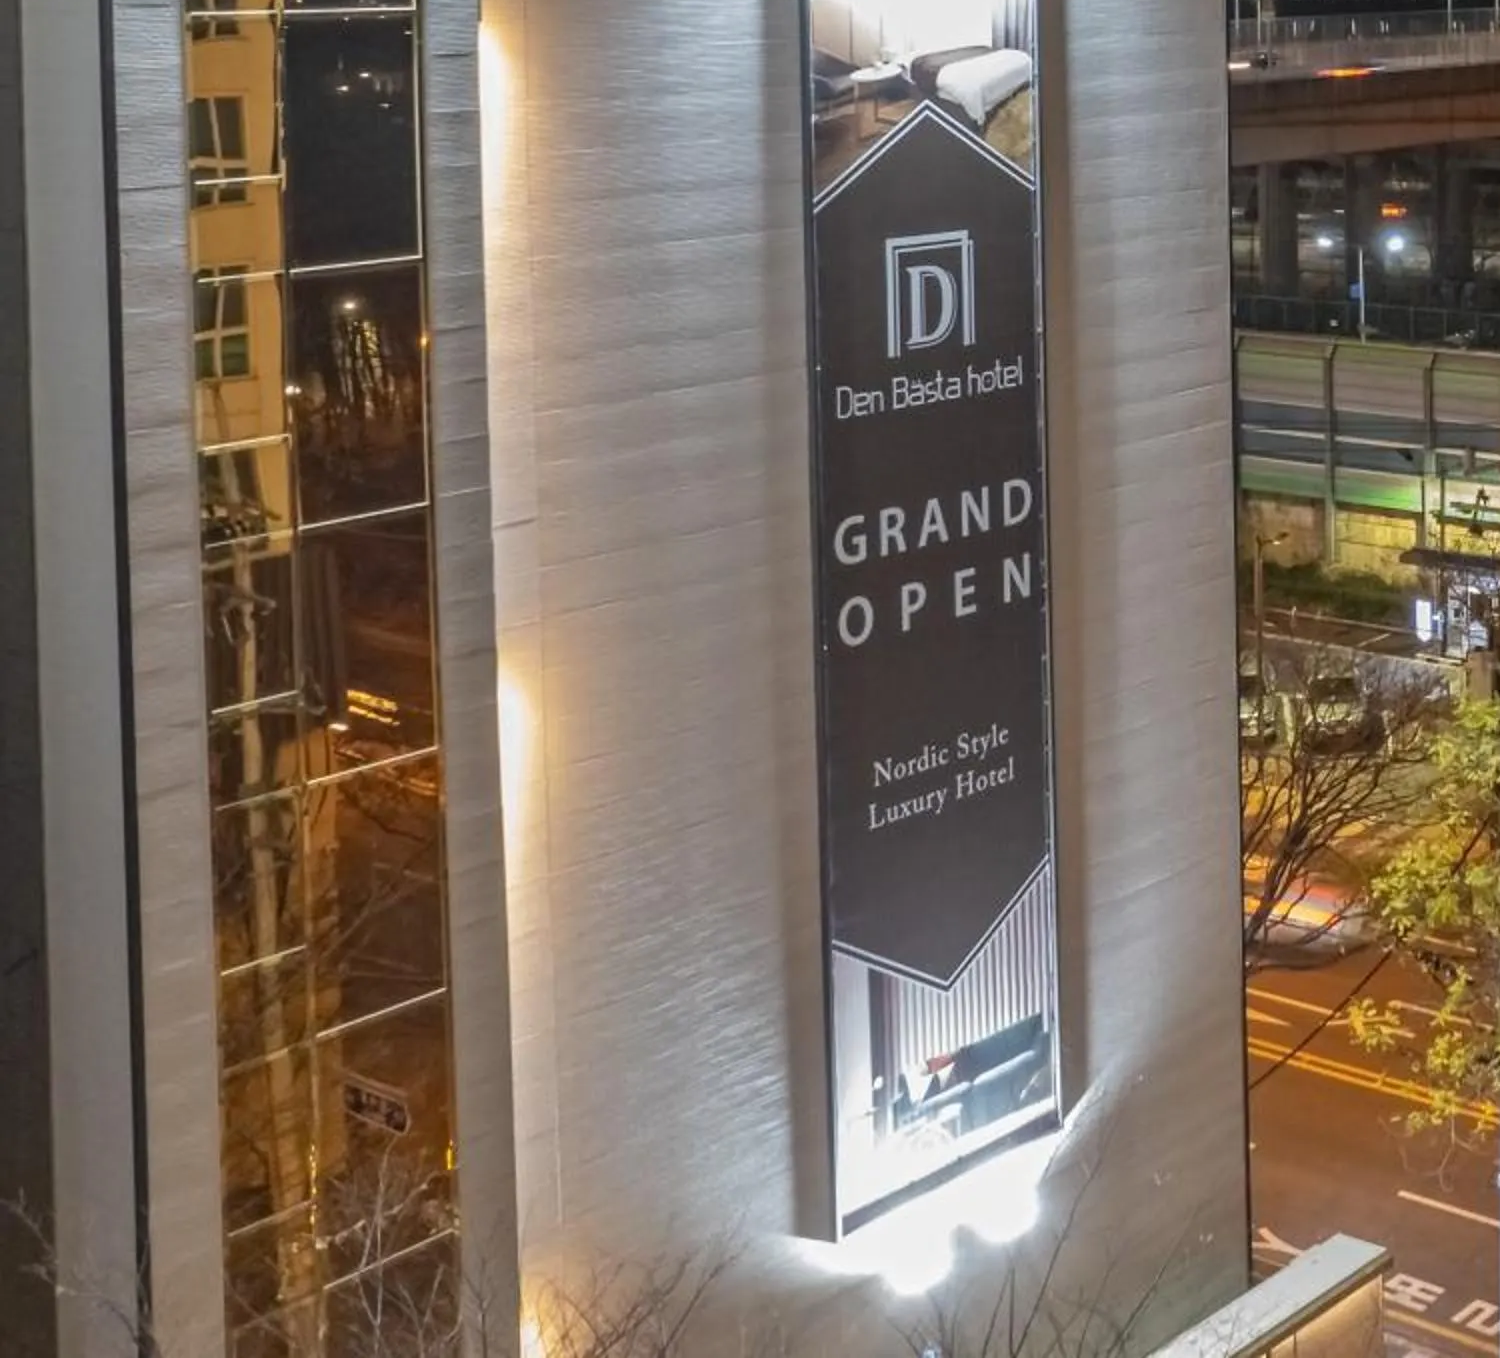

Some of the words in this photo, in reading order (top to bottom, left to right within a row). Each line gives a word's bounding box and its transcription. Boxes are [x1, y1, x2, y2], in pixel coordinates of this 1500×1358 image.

[835, 386, 885, 419] Den
[967, 355, 1023, 396] hotel
[834, 478, 1033, 565] GRAND
[838, 552, 1031, 648] OPEN
[873, 744, 949, 788] Nordic
[957, 722, 1009, 760] Style
[868, 787, 947, 831] Luxury
[955, 756, 1015, 799] Hotel
